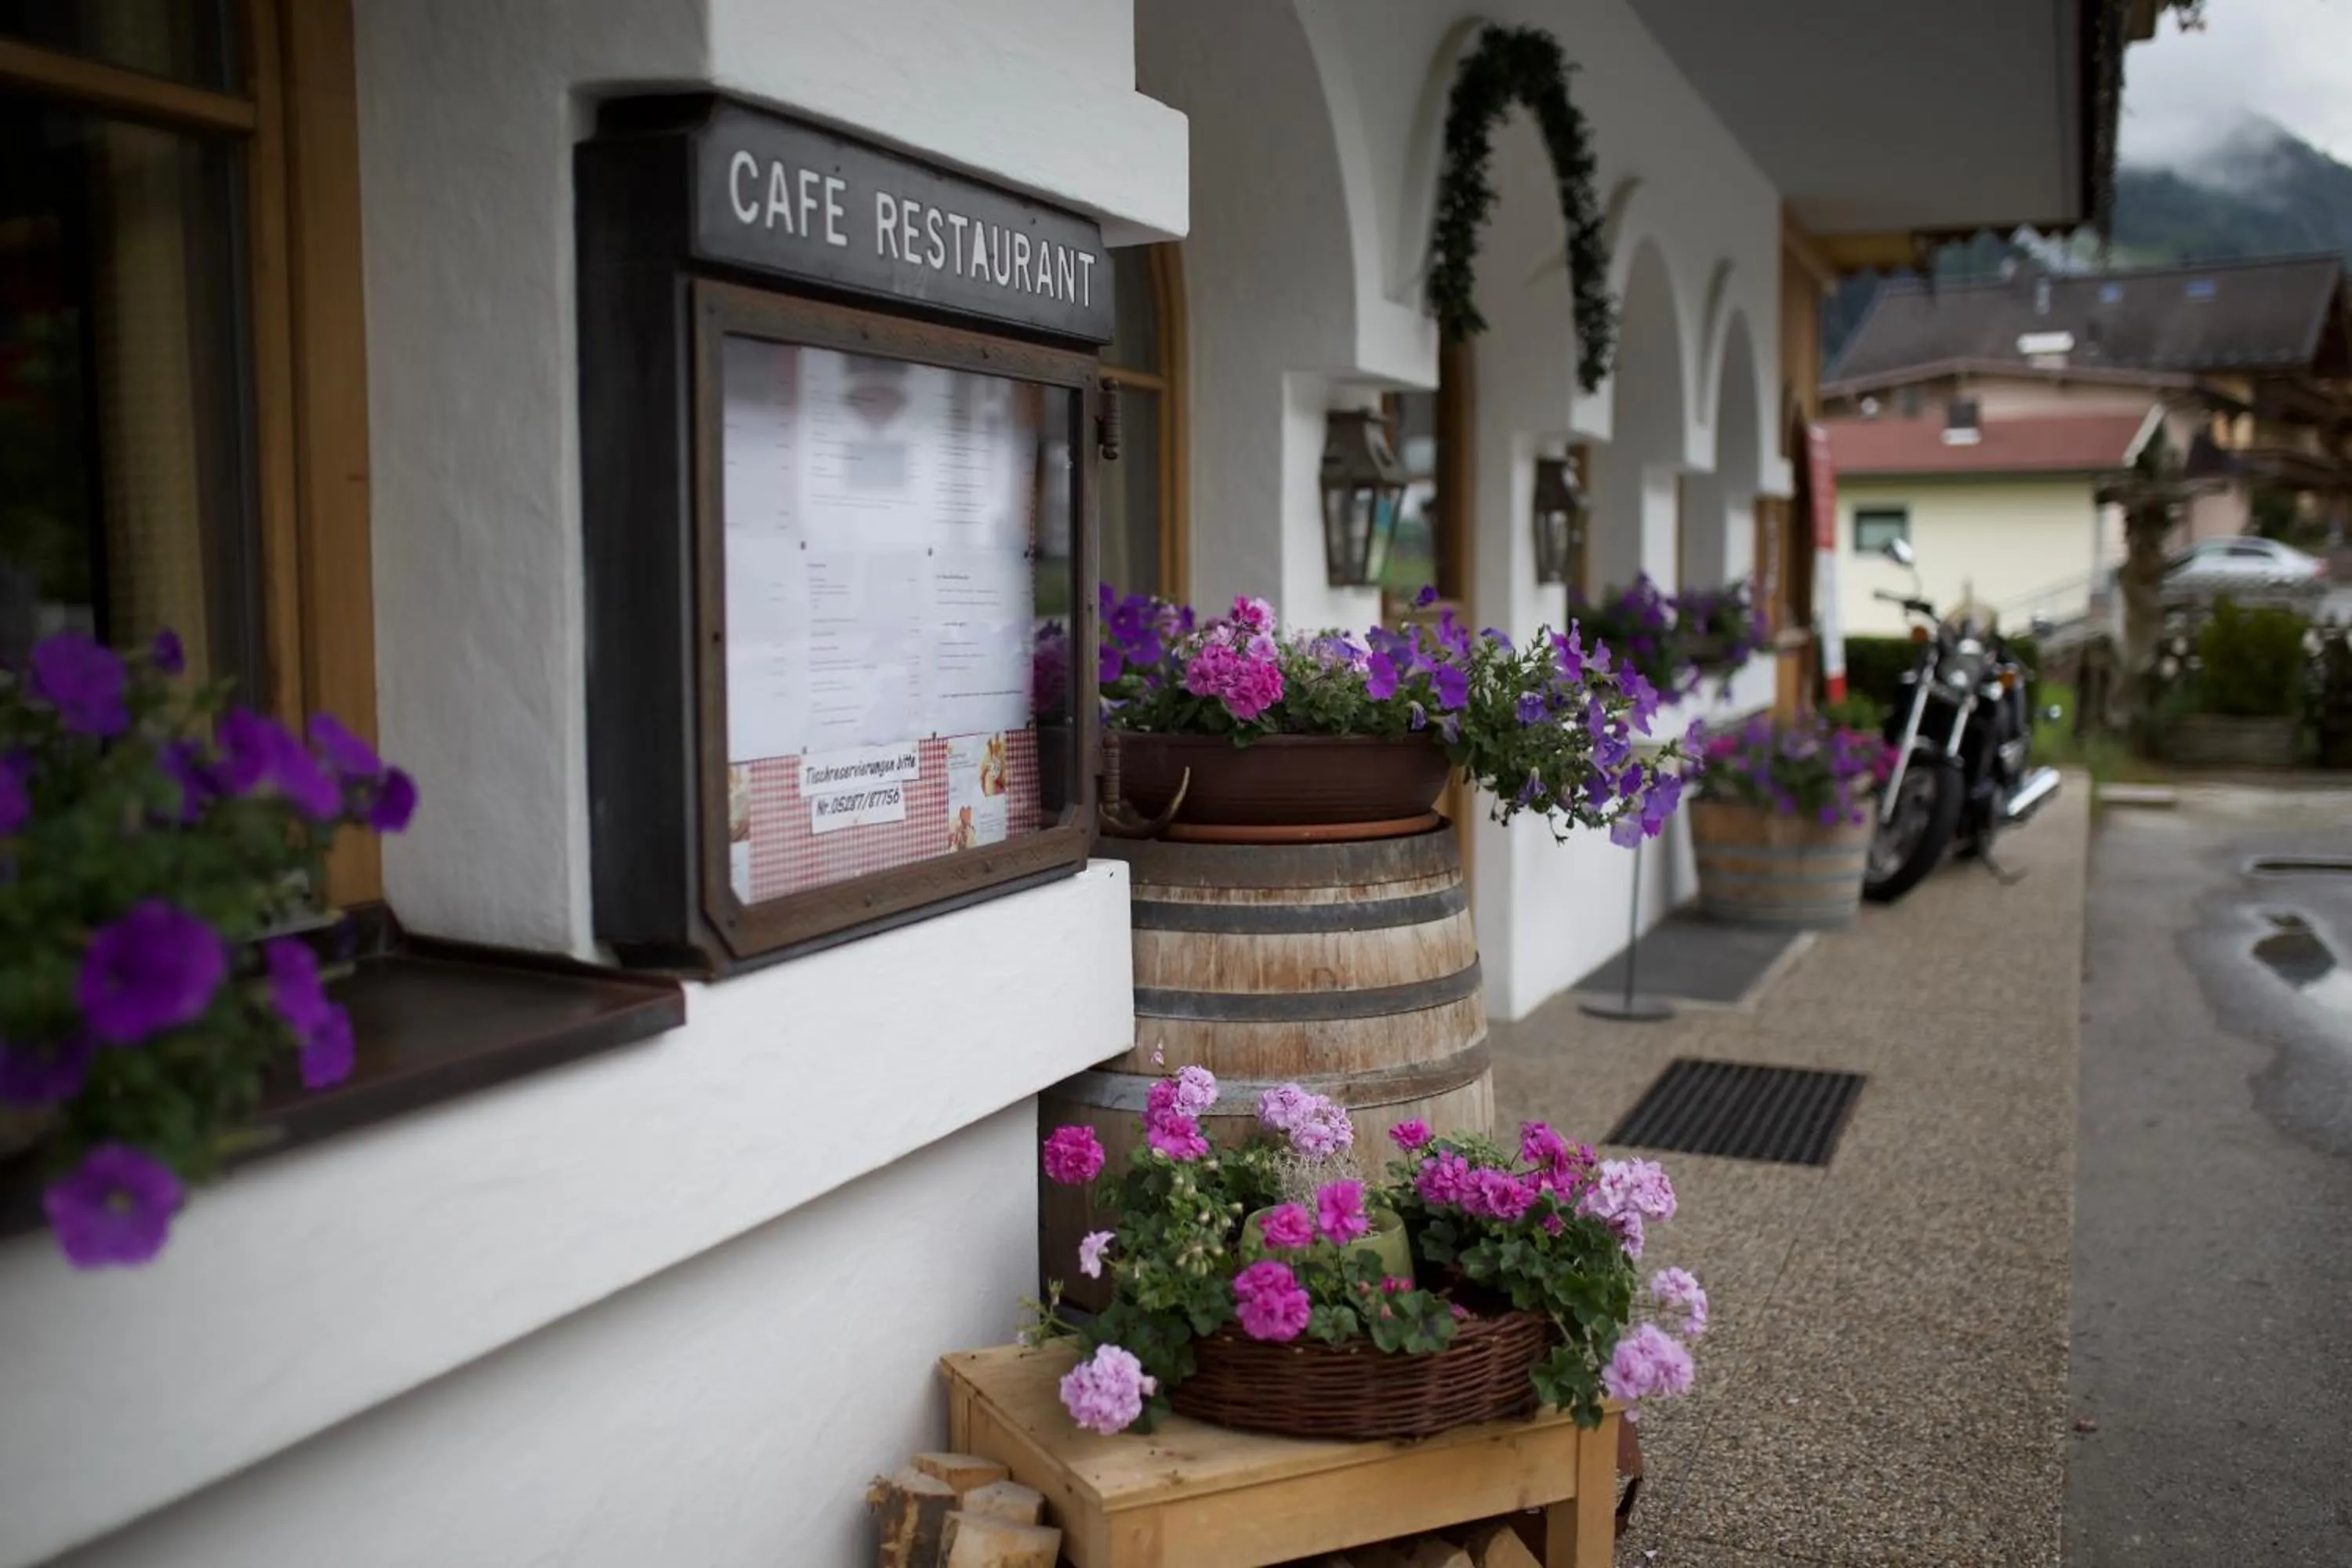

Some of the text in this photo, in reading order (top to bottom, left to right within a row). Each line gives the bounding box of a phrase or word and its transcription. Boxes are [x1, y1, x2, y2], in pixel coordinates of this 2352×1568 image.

[729, 149, 1096, 308] CAFE RESTAURANT
[806, 753, 916, 784] Tischreservierungen bitte
